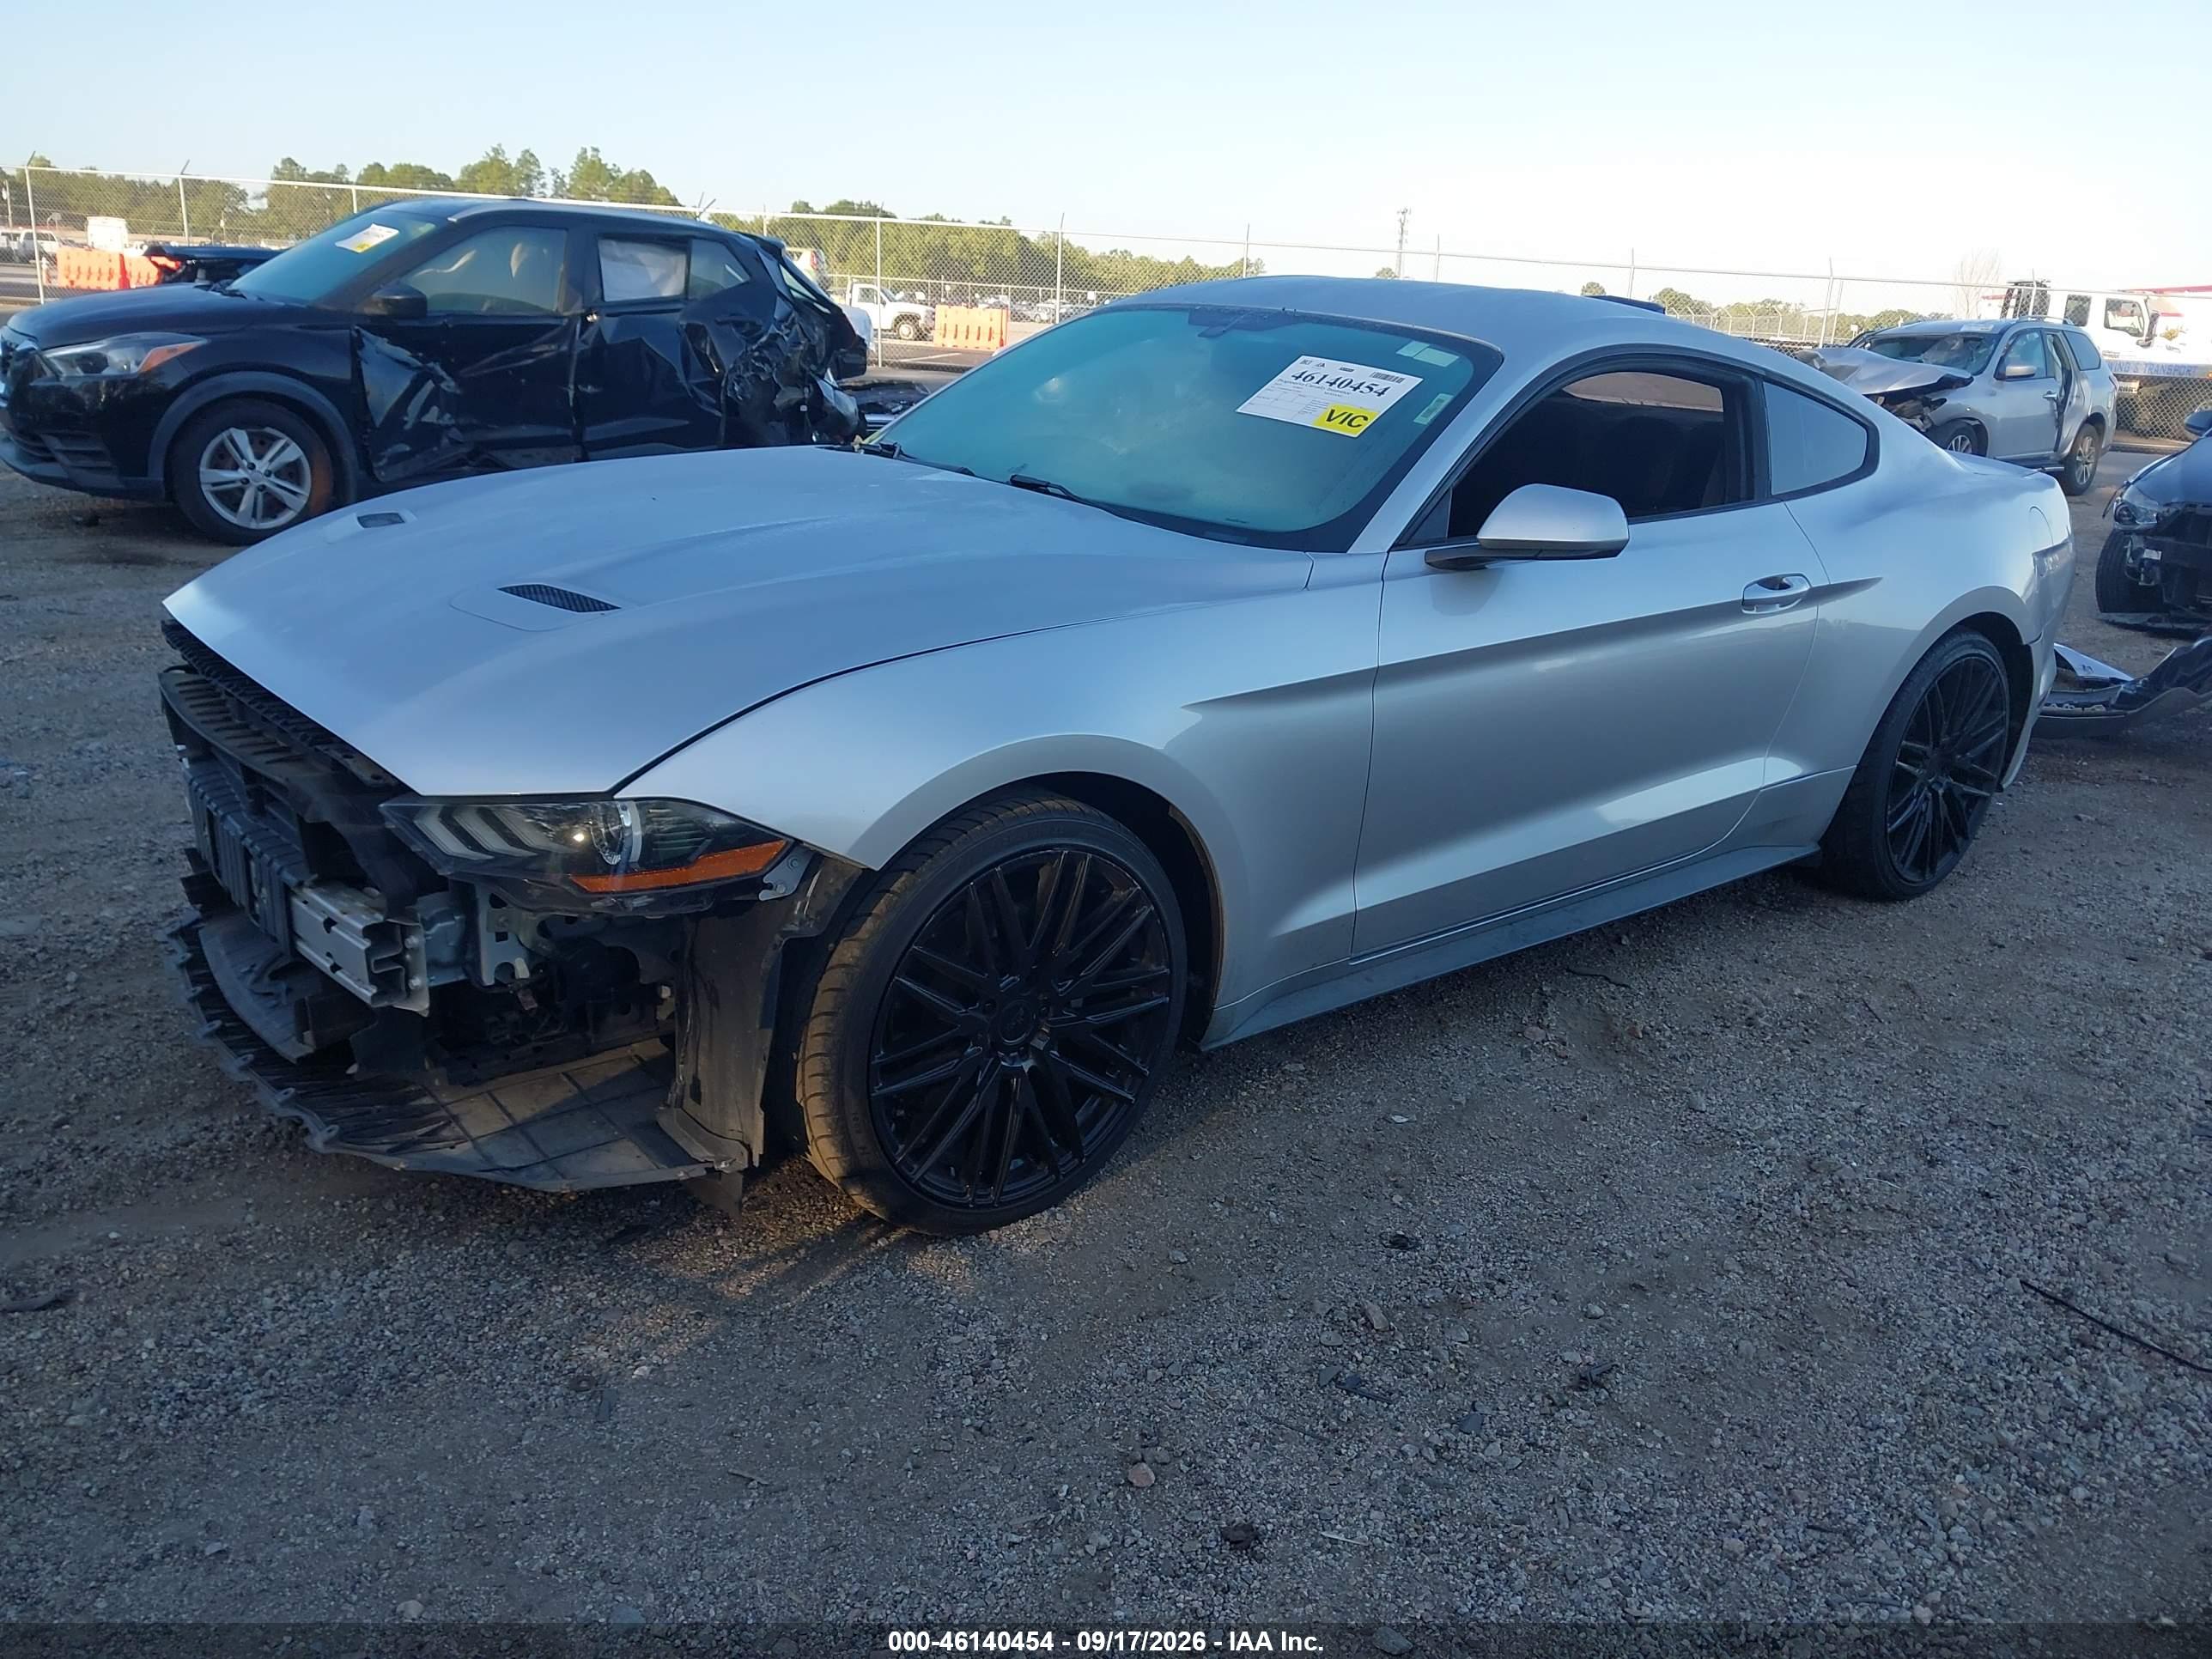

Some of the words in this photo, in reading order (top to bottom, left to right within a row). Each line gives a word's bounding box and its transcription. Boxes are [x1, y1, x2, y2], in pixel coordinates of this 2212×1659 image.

[2143, 362, 2198, 376] TRANSPORT
[1291, 370, 1391, 397] 46140454
[1326, 409, 1368, 428] VIC
